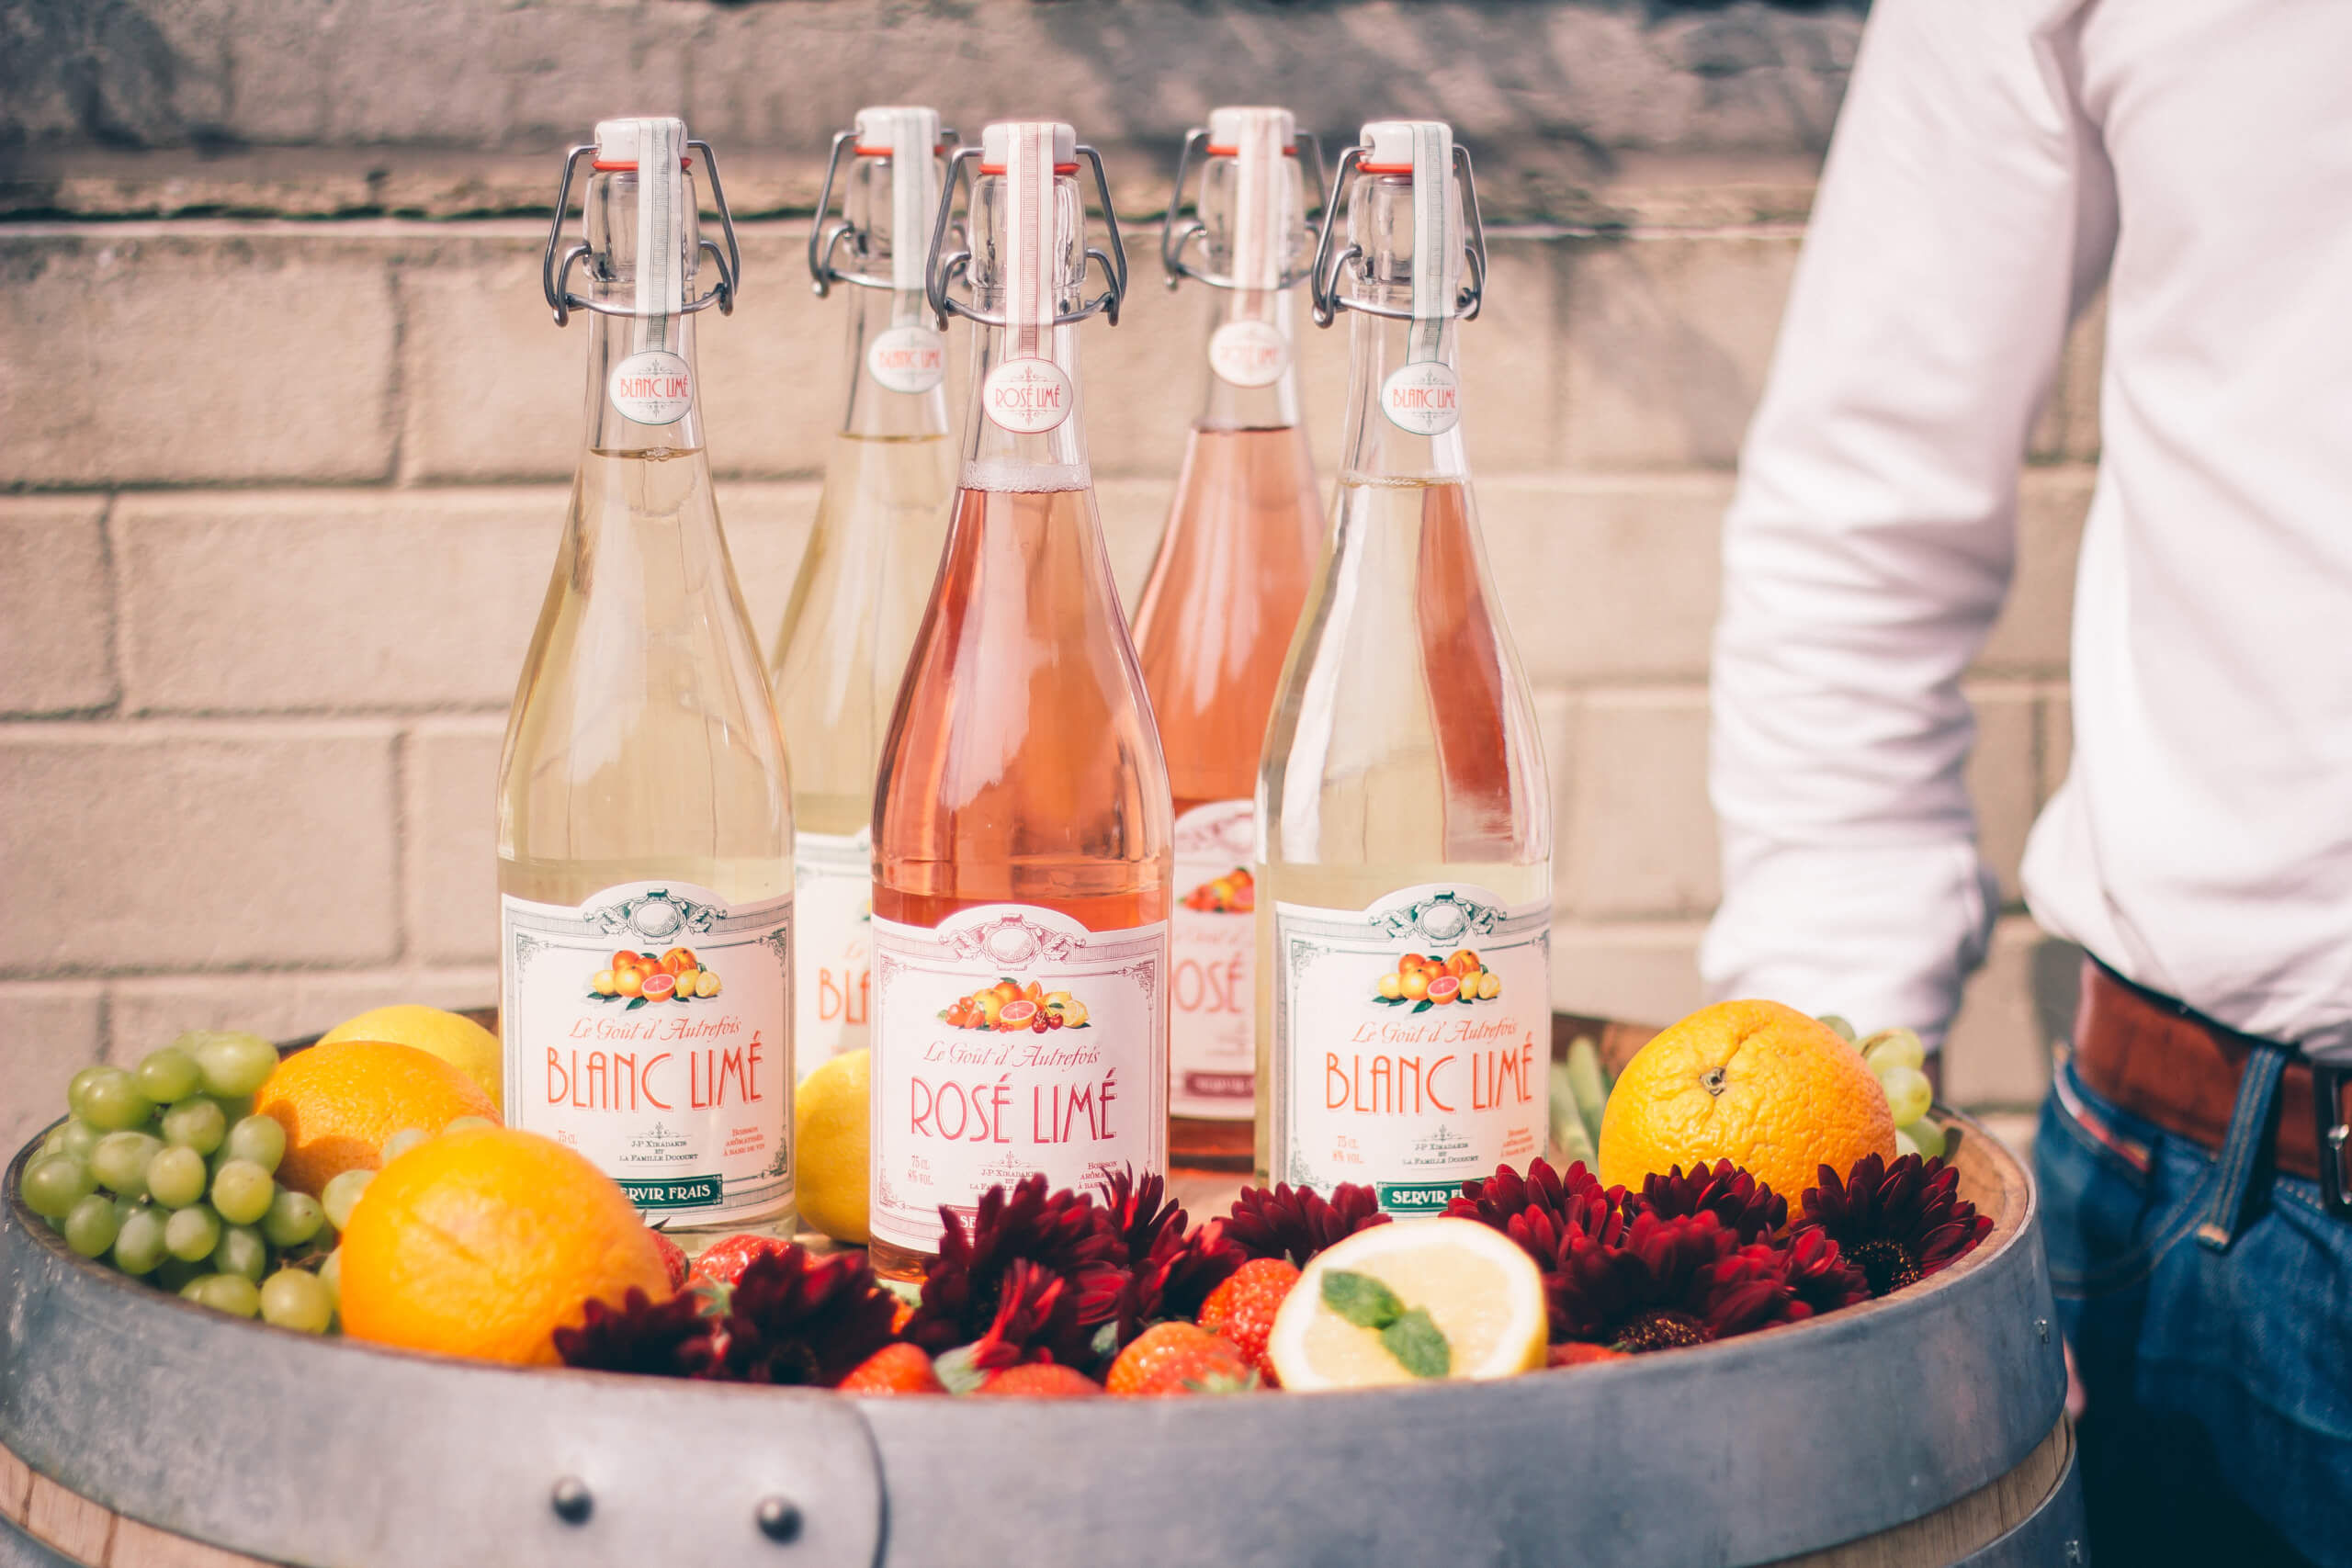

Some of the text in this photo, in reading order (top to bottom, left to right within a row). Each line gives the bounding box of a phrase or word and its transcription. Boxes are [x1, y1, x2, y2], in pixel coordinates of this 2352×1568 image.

[620, 374, 689, 398] BLANC LIMÉ
[995, 384, 1061, 408] ROSÉ LIMÉ
[1393, 389, 1434, 409] BLANC
[1172, 951, 1243, 1014] OSÉ
[569, 1017, 594, 1040] Le
[596, 1017, 639, 1042] Goût
[660, 1014, 742, 1043] Autrefois
[1351, 1021, 1375, 1043] Le
[1381, 1021, 1423, 1044] Goût
[1444, 1017, 1519, 1044] Autrefois
[923, 1040, 947, 1063] Le
[948, 1042, 992, 1066] Goût
[1012, 1044, 1102, 1072] Autrefois
[547, 1030, 764, 1111] BLANC LIMÉ
[1326, 1031, 1533, 1115] BLANC LIMÉ
[910, 1067, 1118, 1145] ROSÉ LIMÉ
[630, 1154, 664, 1162] FAMILLE
[669, 1184, 711, 1200] FRAIS
[1391, 1190, 1449, 1205] SERVIR
